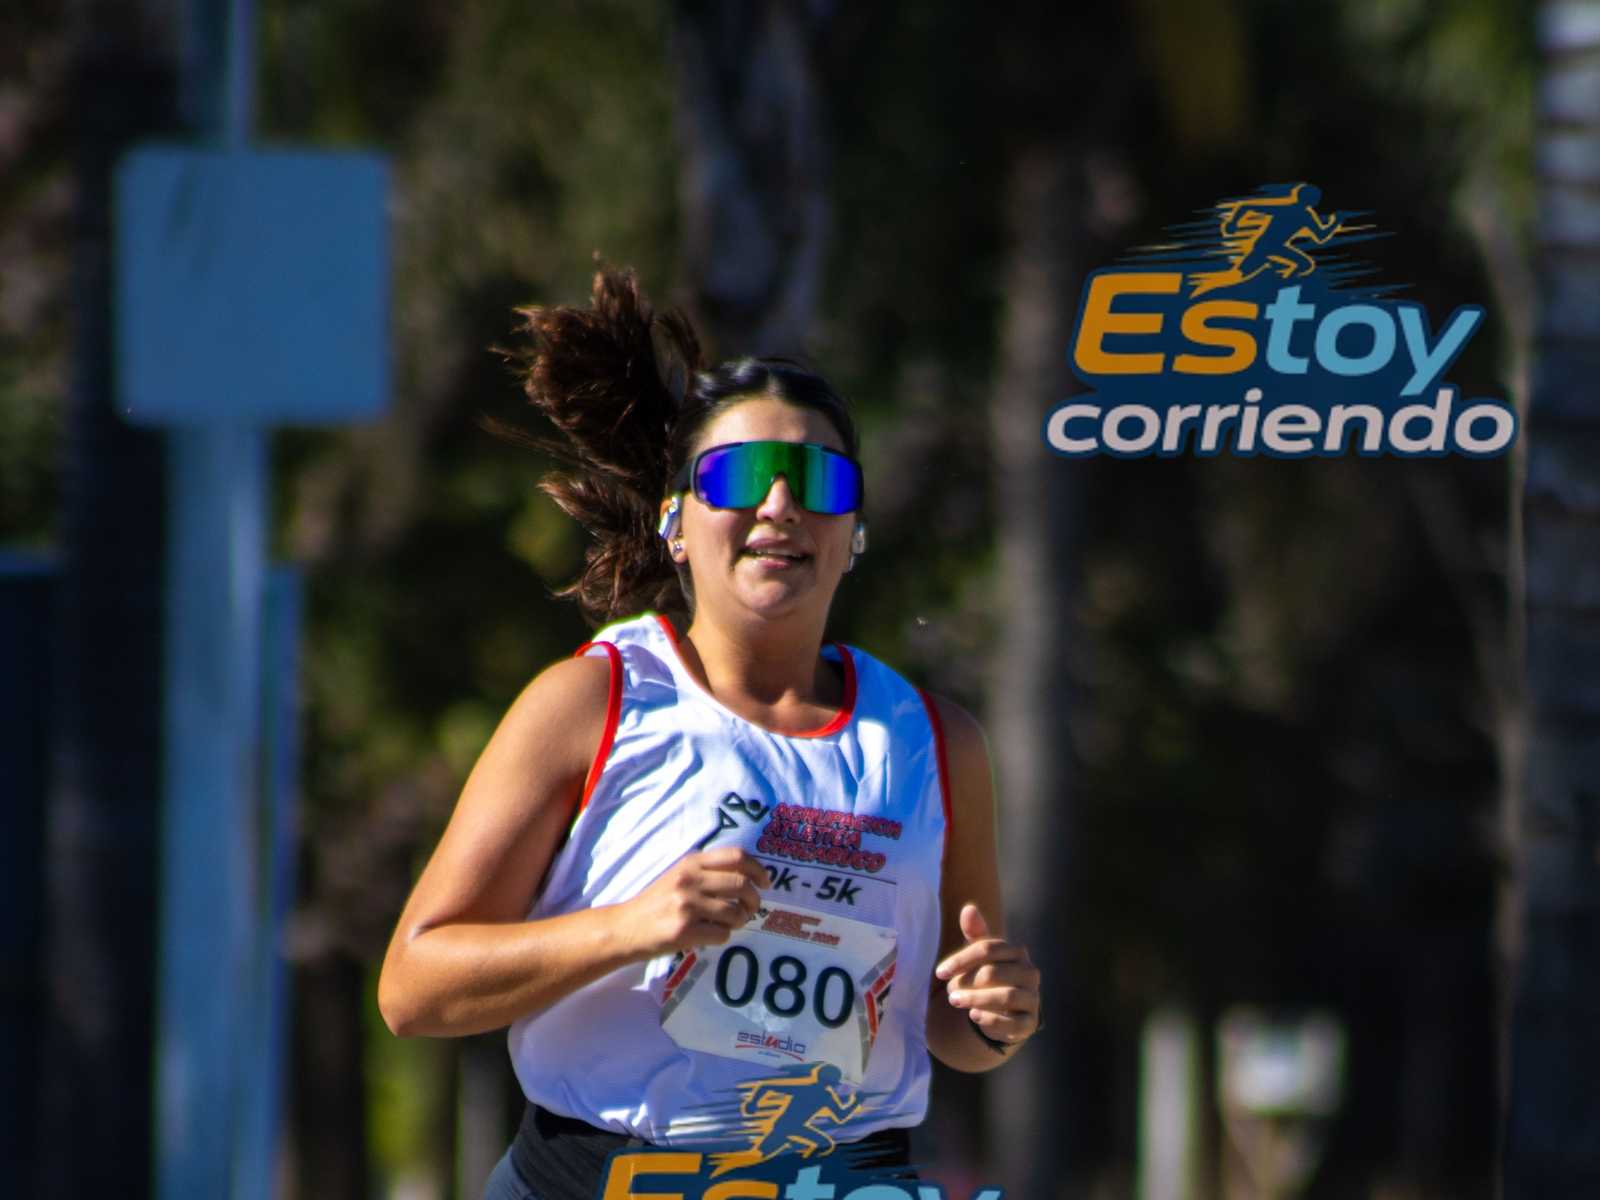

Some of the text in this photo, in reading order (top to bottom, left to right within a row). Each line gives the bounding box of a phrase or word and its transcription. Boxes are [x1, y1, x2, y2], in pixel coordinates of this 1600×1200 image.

[815, 876, 862, 906] 5k
[714, 945, 856, 1029] 080
[736, 1030, 806, 1054] estudio
